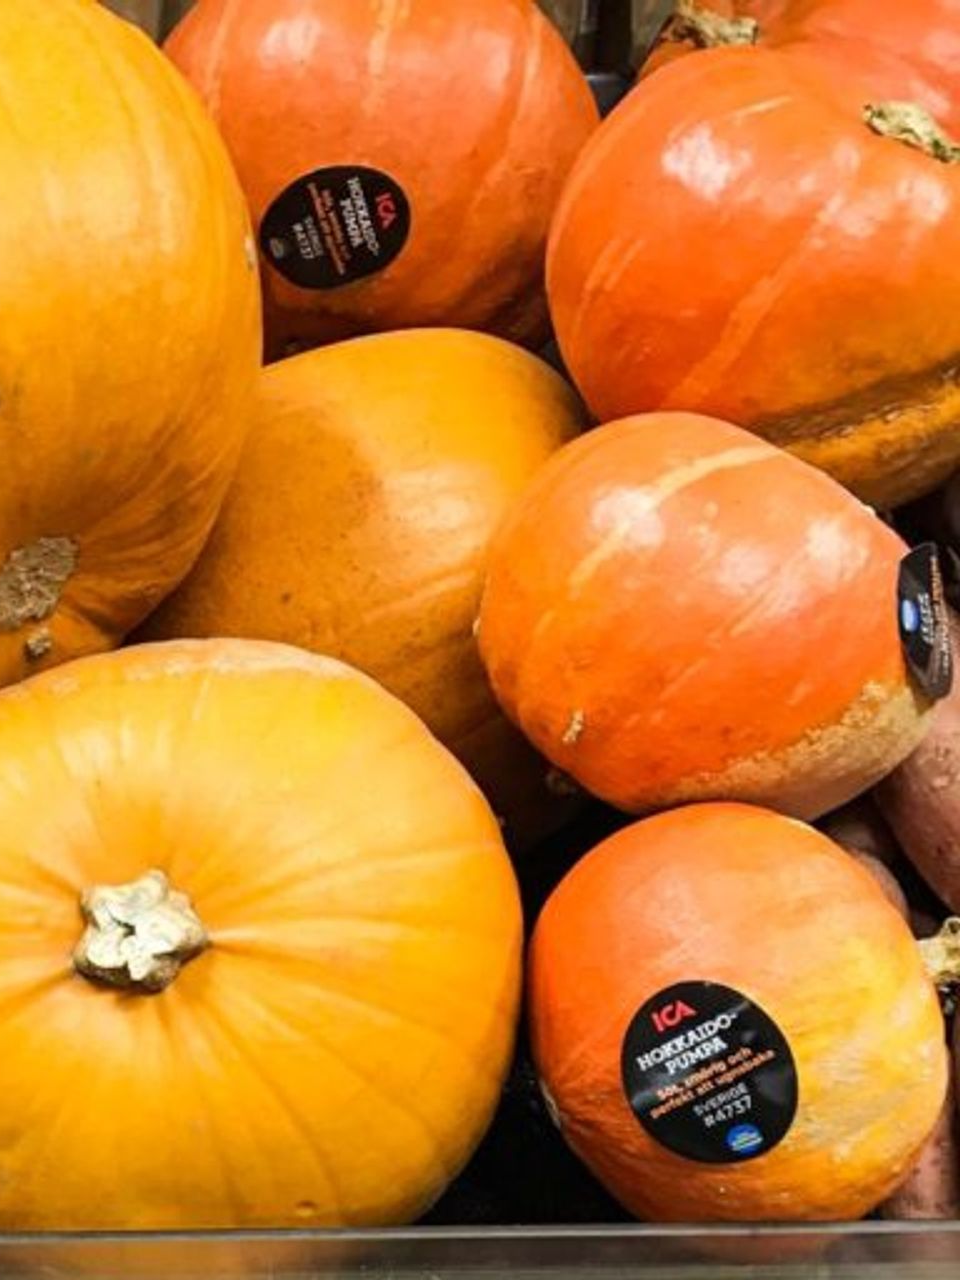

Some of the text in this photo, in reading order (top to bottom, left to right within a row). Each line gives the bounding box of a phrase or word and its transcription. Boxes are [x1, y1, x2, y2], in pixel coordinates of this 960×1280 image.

[376, 193, 396, 229] ICA
[651, 1000, 697, 1032] ICA
[636, 1012, 738, 1072] HOKKAIDO-
[664, 1036, 729, 1076] PUMPA
[703, 1094, 752, 1128] #4737
